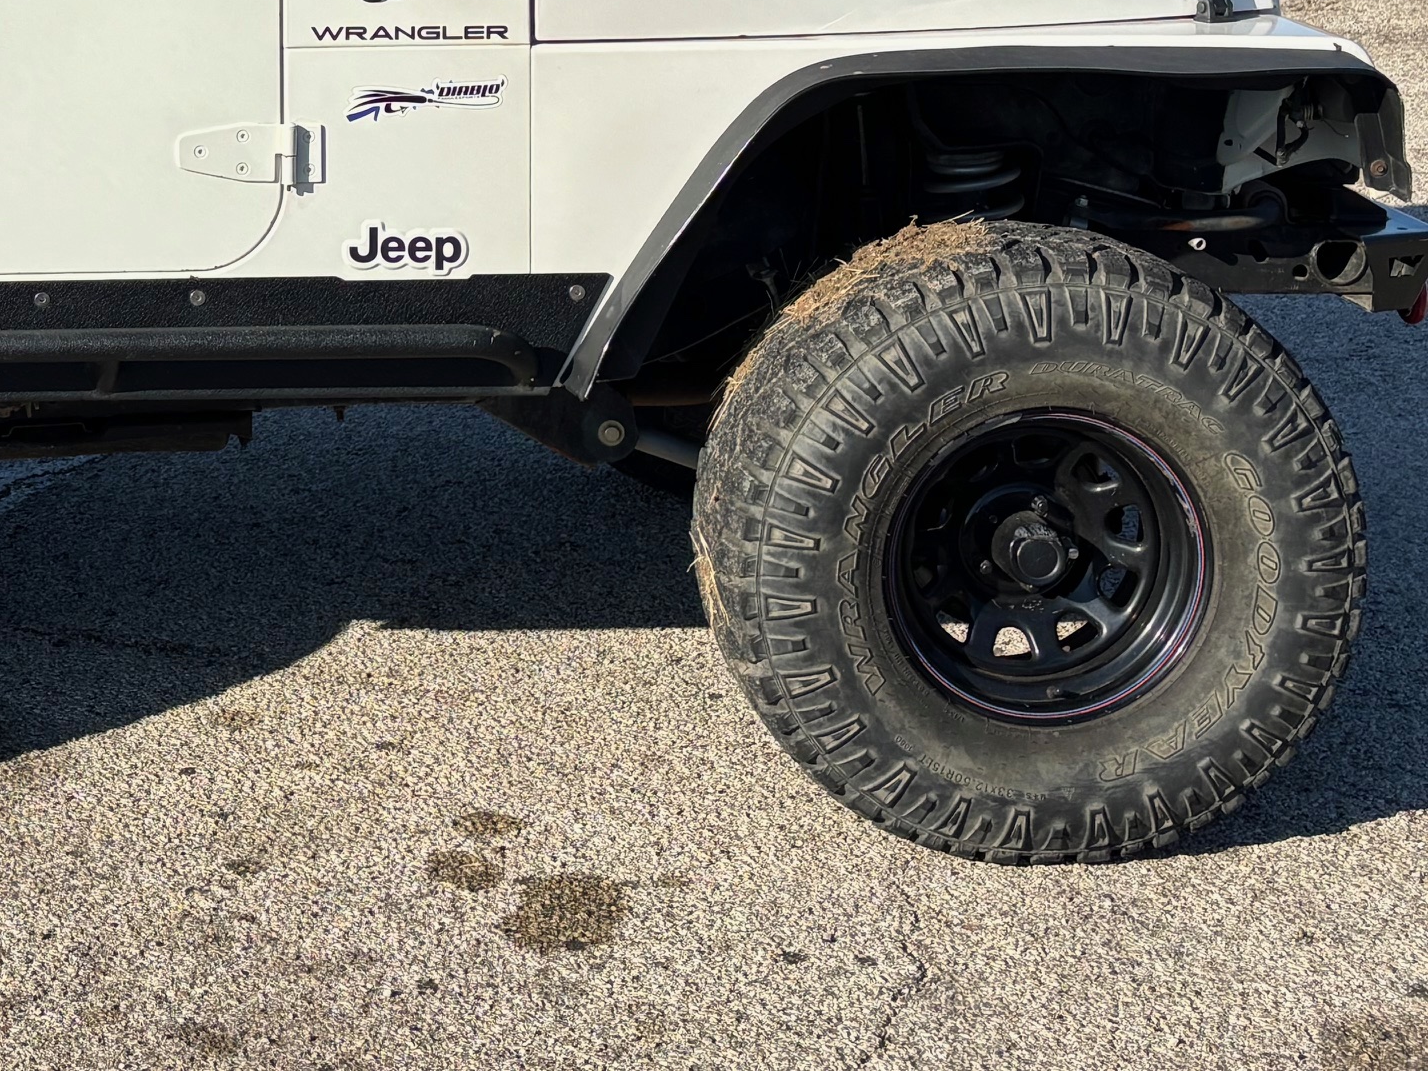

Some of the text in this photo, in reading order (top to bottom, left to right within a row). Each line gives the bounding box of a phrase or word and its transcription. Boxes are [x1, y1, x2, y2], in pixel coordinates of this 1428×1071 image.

[311, 25, 509, 41] WRANGLER
[437, 83, 502, 98] DIABLO
[349, 227, 462, 271] Jeep
[837, 360, 1225, 697] WRANGLER DURATRAC
